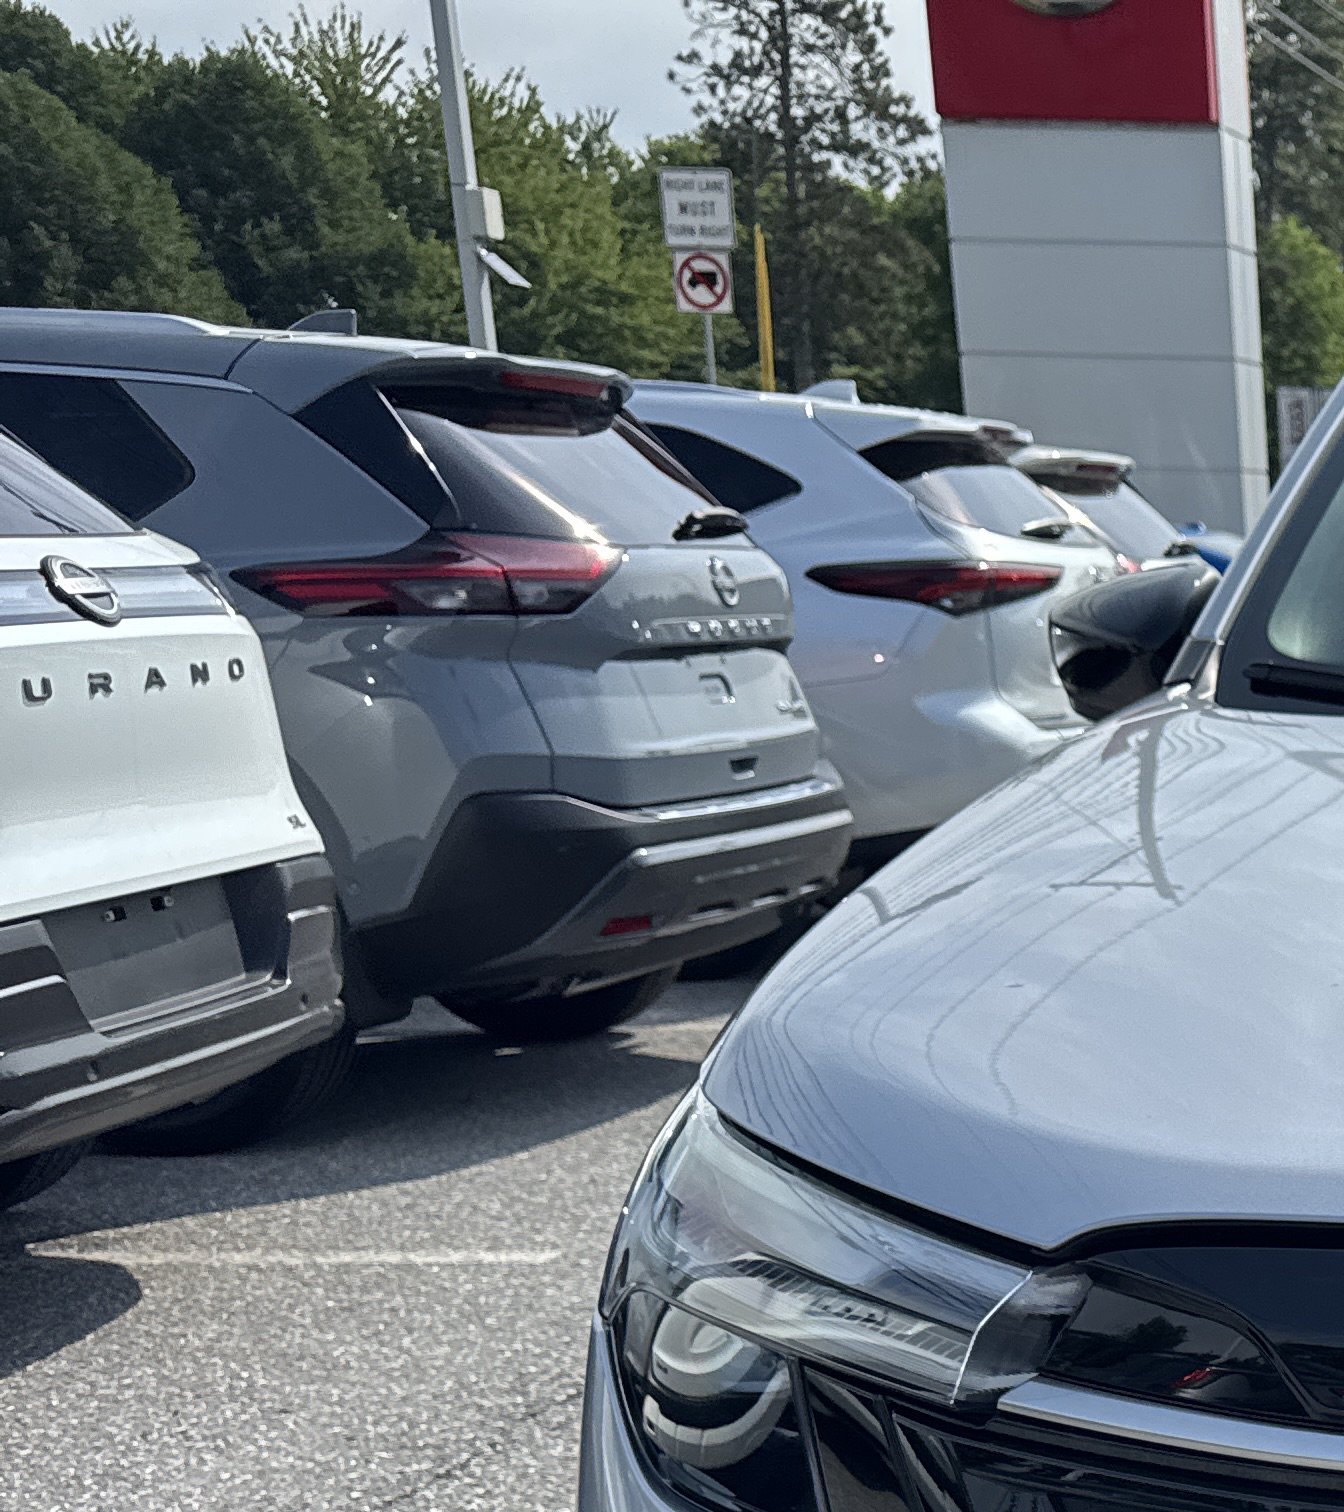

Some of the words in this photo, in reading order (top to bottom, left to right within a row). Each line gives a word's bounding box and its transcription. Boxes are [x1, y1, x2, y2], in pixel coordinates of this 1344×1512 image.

[665, 177, 695, 191] RIGHT
[678, 200, 716, 216] MUST
[667, 223, 696, 237] TURN
[700, 224, 730, 237] RIGHT
